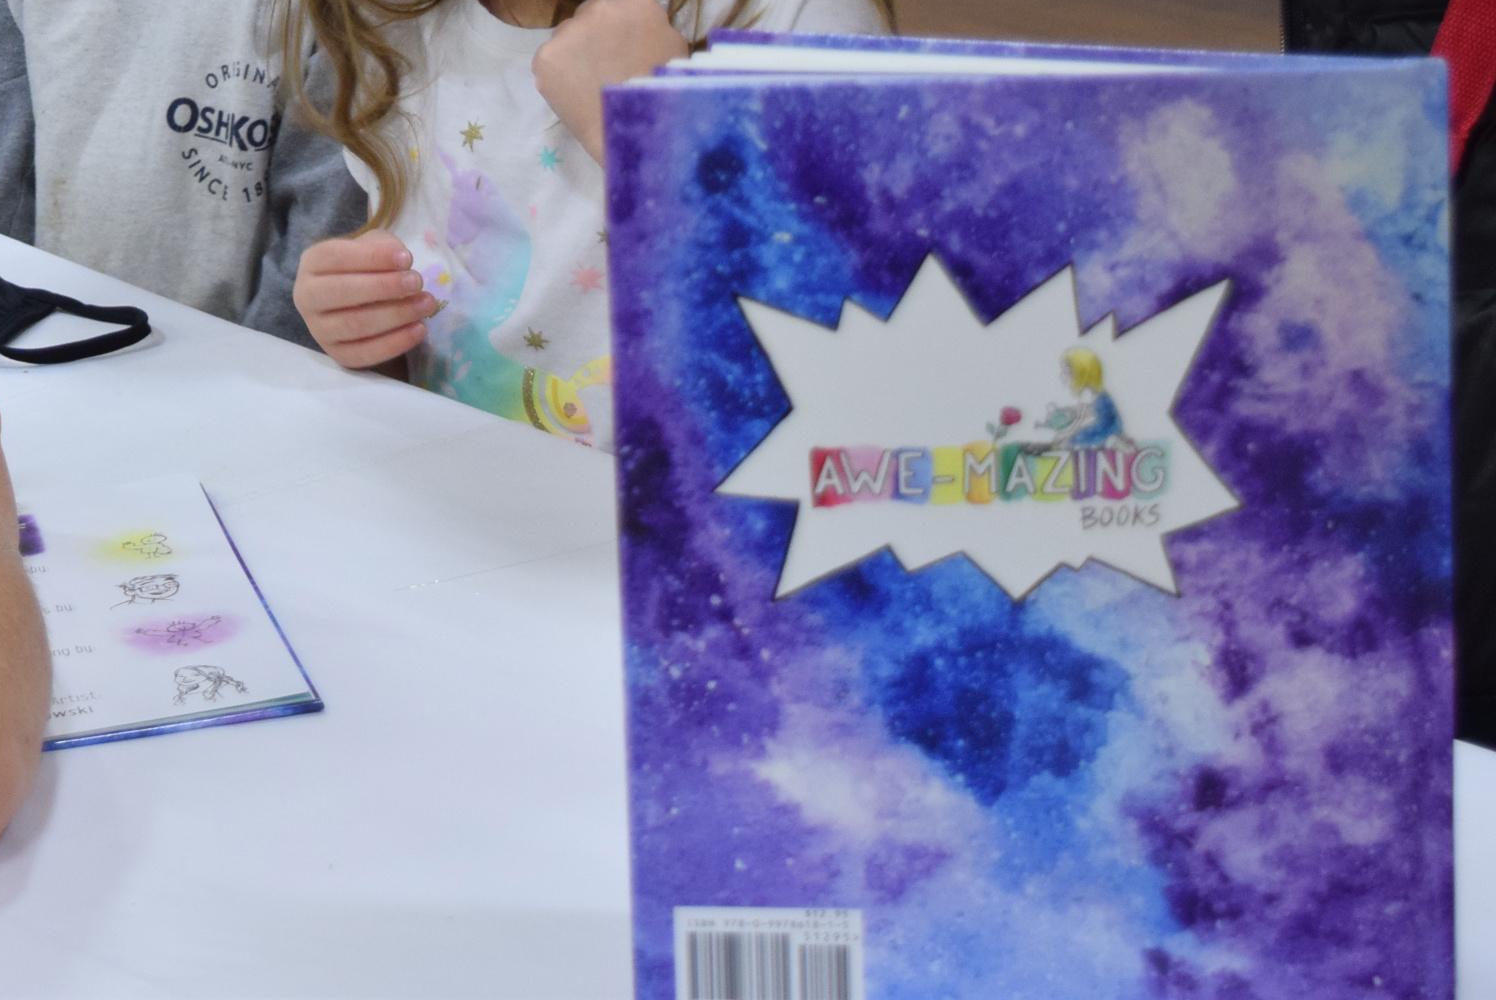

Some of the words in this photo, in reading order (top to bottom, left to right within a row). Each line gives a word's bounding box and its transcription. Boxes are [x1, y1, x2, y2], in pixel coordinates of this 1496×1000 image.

[166, 97, 269, 152] OSHKO
[813, 445, 1169, 494] AWE-MAZING
[1080, 502, 1162, 531] BOOKS
